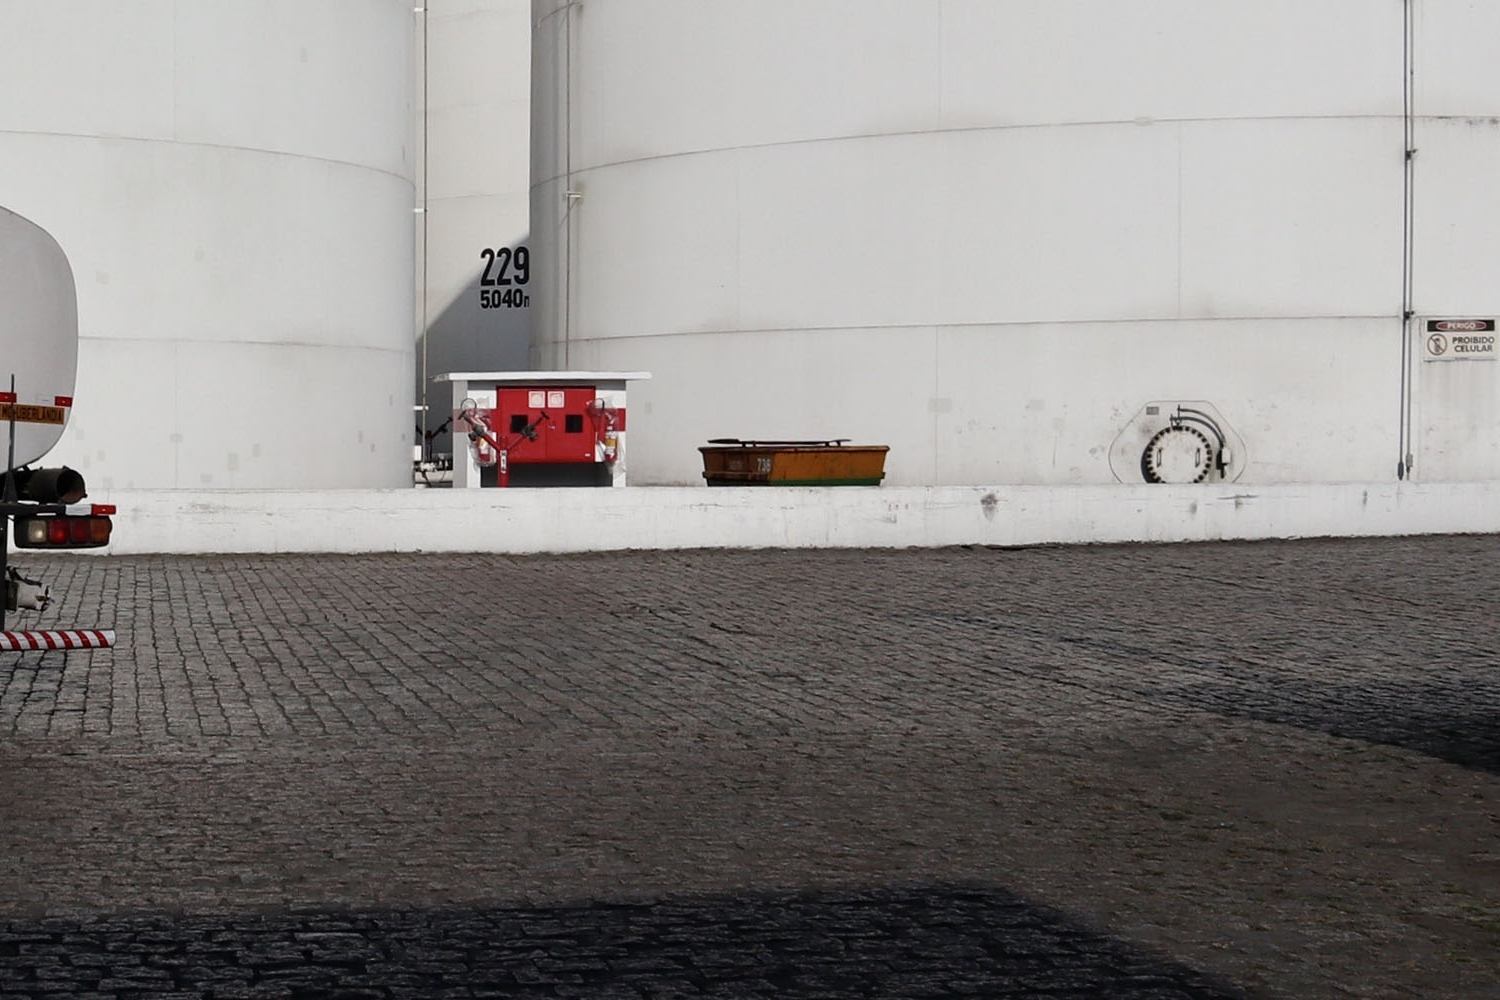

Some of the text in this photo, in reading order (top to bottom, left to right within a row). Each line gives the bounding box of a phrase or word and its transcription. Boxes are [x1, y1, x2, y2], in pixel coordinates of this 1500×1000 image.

[480, 246, 530, 286] 229
[1452, 336, 1495, 344] PROIBIDO
[1453, 345, 1493, 353] CELULAR
